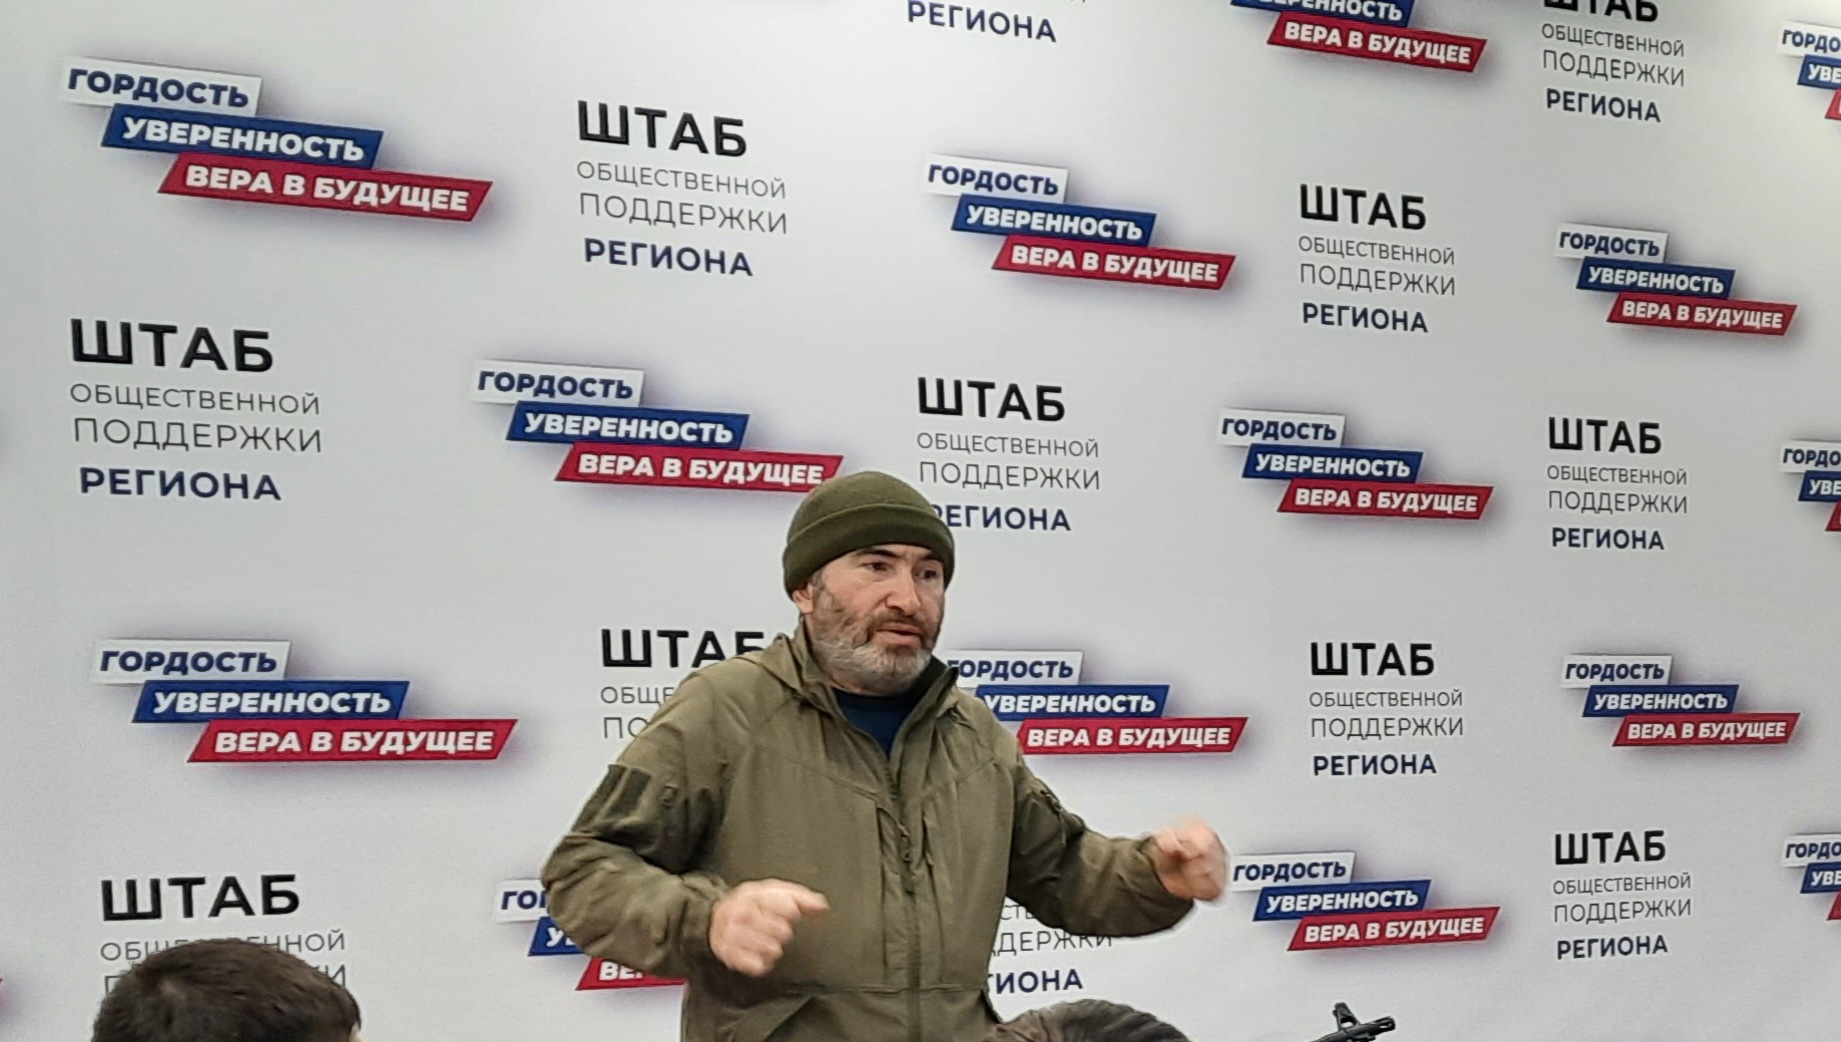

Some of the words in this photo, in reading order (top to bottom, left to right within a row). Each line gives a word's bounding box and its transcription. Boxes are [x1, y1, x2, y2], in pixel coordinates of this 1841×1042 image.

[908, 0, 1056, 42] РЕГИОНА
[1256, 0, 1402, 21] ННОСТЬ
[1285, 22, 1342, 47] ВЕРА
[1348, 31, 1363, 48] В
[1368, 35, 1471, 65] БУДУЩЕЕ
[1541, 23, 1684, 57] ОБЩЕСТВЕННОЙ
[1543, 49, 1685, 88] ПОДДЕРЖКИ
[68, 68, 248, 108] ГОРДОСТЬ
[1546, 88, 1661, 123] РЕГИОНА
[123, 117, 364, 161] УВЕРЕННОСТЬ
[578, 100, 747, 157] ШТАБ
[186, 165, 272, 194] ВЕРА
[283, 174, 305, 196] В
[314, 177, 468, 212] БУДУЩЕЕ
[577, 161, 785, 199] ОБЩЕСТВЕННОЙ
[928, 164, 1058, 195] ГОРДОСТЬ
[580, 193, 787, 234] ПОДДЕРЖКИ
[1300, 184, 1426, 230] ШТАБ
[966, 205, 1143, 240] УВЕРЕННОСТЬ
[585, 238, 753, 276] РЕГИОНА
[1298, 236, 1455, 265] ОБЩЕСТВЕННОЙ
[1559, 231, 1660, 257] ГОРДОСТЬ
[1012, 245, 1076, 269] ВЕРА
[1083, 252, 1099, 271] В
[1105, 254, 1219, 283] БУДУЩЕЕ
[1300, 263, 1455, 296] ПОДДЕРЖКИ
[1588, 266, 1724, 294] УВЕРЕННОСТЬ
[1303, 303, 1428, 332] РЕГИОНА
[1622, 300, 1672, 321] ВЕРА
[1676, 304, 1689, 321] В
[1694, 305, 1783, 329] БУДУЩЕЕ
[71, 318, 272, 372] ШТАБ
[70, 383, 320, 415] ОБЩЕСТВЕННОЙ
[478, 371, 633, 399] ГОРДОСТЬ
[917, 377, 1065, 421] ШТАБ
[74, 418, 321, 452] ПОДДЕРЖКИ
[524, 413, 733, 444] УВЕРЕННОСТЬ
[1222, 418, 1337, 441] ГОРДОСТЬ
[1548, 416, 1661, 454] ШТАБ
[917, 432, 1098, 458] ОБЩЕСТВЕННОЙ
[578, 454, 654, 476] ВЕРА
[662, 458, 681, 478] В
[689, 459, 823, 485] БУДУЩЕЕ
[919, 461, 1100, 490] ПОДДЕРЖКИ
[1255, 453, 1411, 477] УВЕРЕННОСТЬ
[1547, 465, 1687, 486] ОБЩЕСТВЕННОЙ
[80, 467, 281, 500] РЕГИОНА
[1295, 488, 1351, 507] ВЕРА
[1357, 491, 1371, 507] В
[1377, 492, 1477, 513] БУДУЩЕЕ
[1549, 490, 1688, 515] ПОДДЕРЖКИ
[1552, 528, 1664, 551] РЕГИОНА
[100, 651, 277, 675] ГОРДОСТЬ
[1310, 642, 1435, 676] ШТАБ
[1565, 663, 1665, 682] ГОРДОСТЬ
[154, 691, 390, 713] УВЕРЕННОСТЬ
[984, 695, 1156, 714] УВЕРЕННОСТЬ
[1309, 689, 1463, 709] ОБЩЕСТВЕННОЙ
[1594, 693, 1728, 711] УВЕРЕННОСТЬ
[215, 731, 300, 753] ВЕРА
[311, 732, 332, 752] В
[341, 731, 493, 754] БУДУЩЕЕ
[1027, 729, 1090, 747] ВЕРА
[1098, 729, 1112, 745] В
[1118, 727, 1231, 748] БУДУЩЕЕ
[1311, 717, 1463, 740] ПОДДЕРЖКИ
[1627, 723, 1676, 740] ВЕРА
[1681, 723, 1694, 739] В
[1698, 722, 1786, 741] БУДУЩЕЕ
[1313, 754, 1437, 775] РЕГИОНА
[1554, 830, 1666, 865] ШТАБ
[1233, 861, 1347, 882] ГОРДОСТЬ
[1552, 871, 1692, 896] ОБЩЕСТВЕННОЙ
[101, 874, 299, 921] ШТАБ
[1266, 890, 1419, 913] УВЕРЕННОСТЬ
[1553, 898, 1692, 925] ПОДДЕРЖКИ
[993, 931, 1112, 957] ДЕРЖКИ
[1304, 923, 1360, 942] ВЕРА
[1366, 923, 1380, 939] В
[1385, 917, 1484, 939] БУДУЩЕЕ
[1556, 934, 1669, 960] РЕГИОНА
[988, 969, 1083, 994] ИОНА
